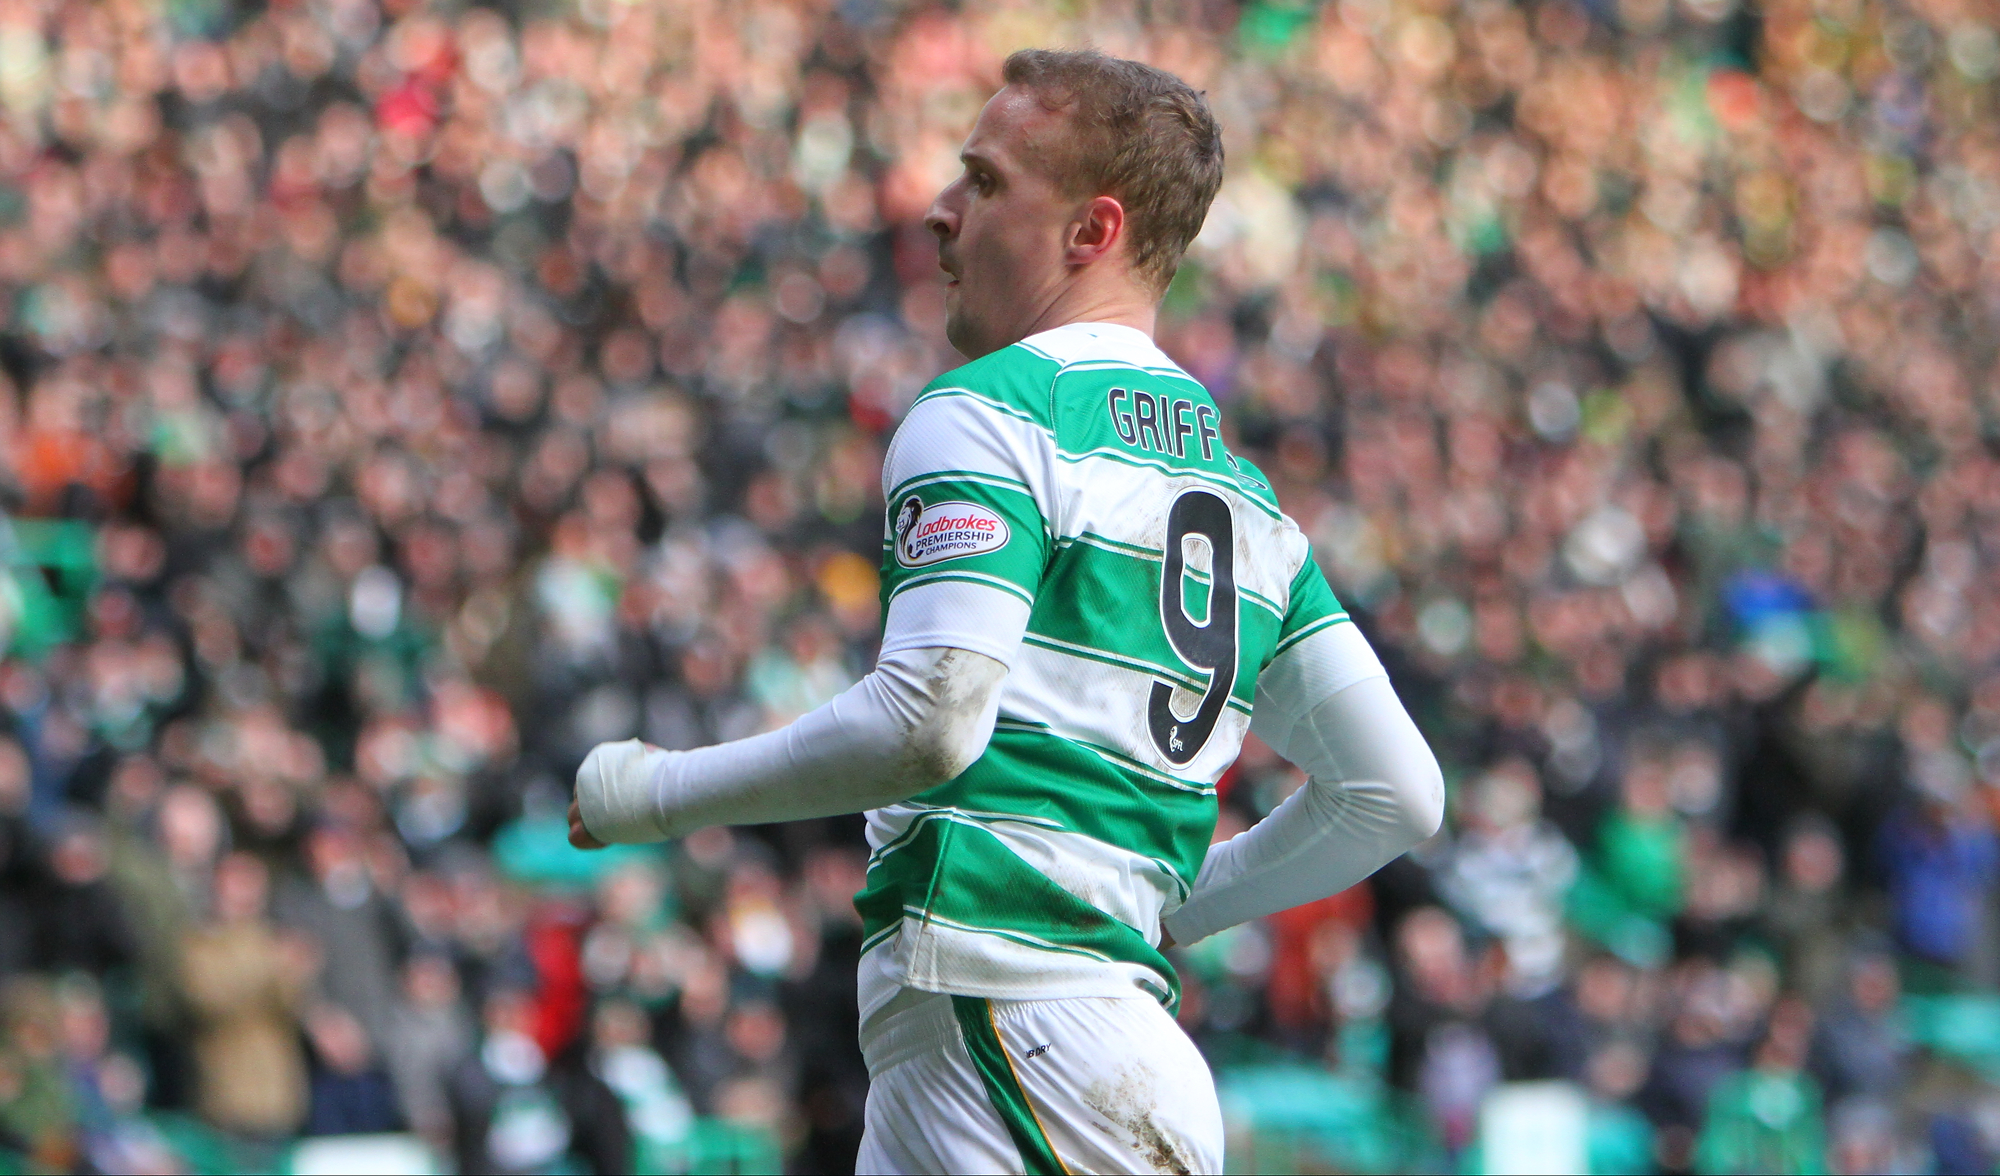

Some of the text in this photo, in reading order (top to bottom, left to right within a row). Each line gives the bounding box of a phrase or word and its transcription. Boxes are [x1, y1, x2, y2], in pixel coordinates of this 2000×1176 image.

[917, 514, 998, 539] Ladbrokes
[915, 531, 994, 551] PREMIERSHIP
[925, 542, 977, 556] CHAMPIONS
[1146, 486, 1239, 770] 9
[1035, 1043, 1052, 1057] DRY
